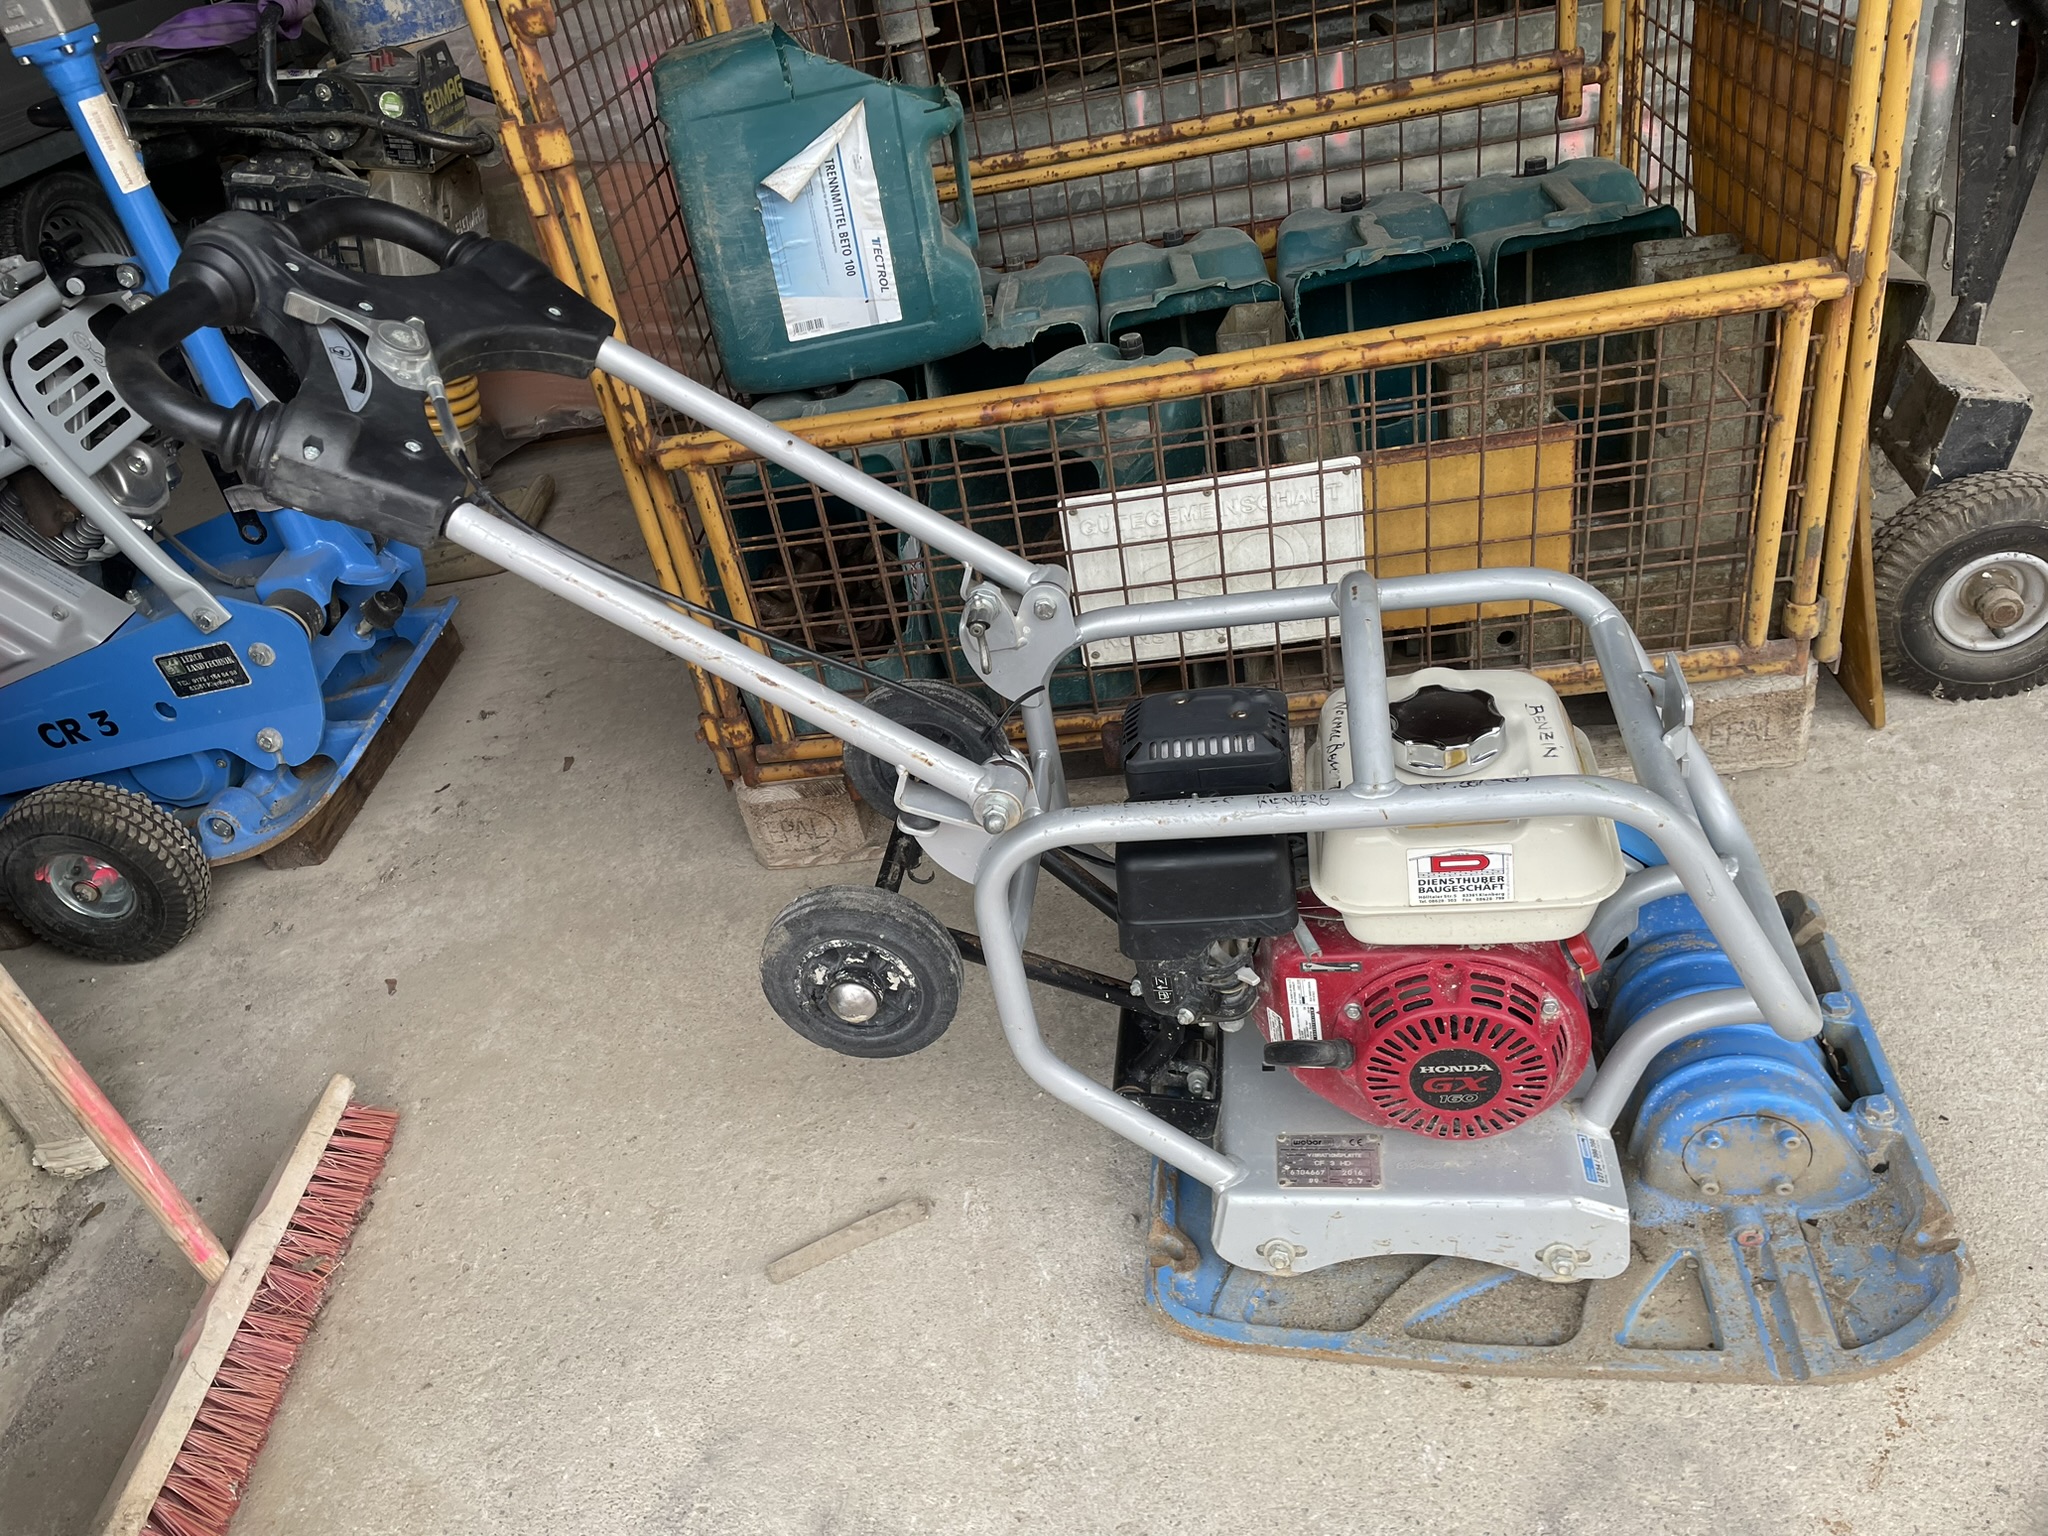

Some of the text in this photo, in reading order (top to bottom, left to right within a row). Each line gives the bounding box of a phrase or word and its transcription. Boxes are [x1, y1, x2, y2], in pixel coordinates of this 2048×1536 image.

[423, 74, 465, 114] BOMAG
[824, 157, 857, 277] TRENNMITTEL BETO 100
[871, 236, 890, 293] TECTROL
[1079, 481, 1343, 538] GÜTEGEMENSCHAFT
[180, 652, 205, 664] LERCH
[186, 656, 235, 673] LANDTECHNIK
[37, 709, 119, 749] CR 3
[1417, 875, 1505, 886] DIENSTHUBER
[1418, 882, 1505, 894] BAUGESCHÄFT
[1419, 1064, 1494, 1074] HONDA
[1422, 1075, 1490, 1093] GX
[1439, 1093, 1479, 1104] 160
[1293, 1138, 1323, 1146] weber
[1341, 1168, 1364, 1176] 2016
